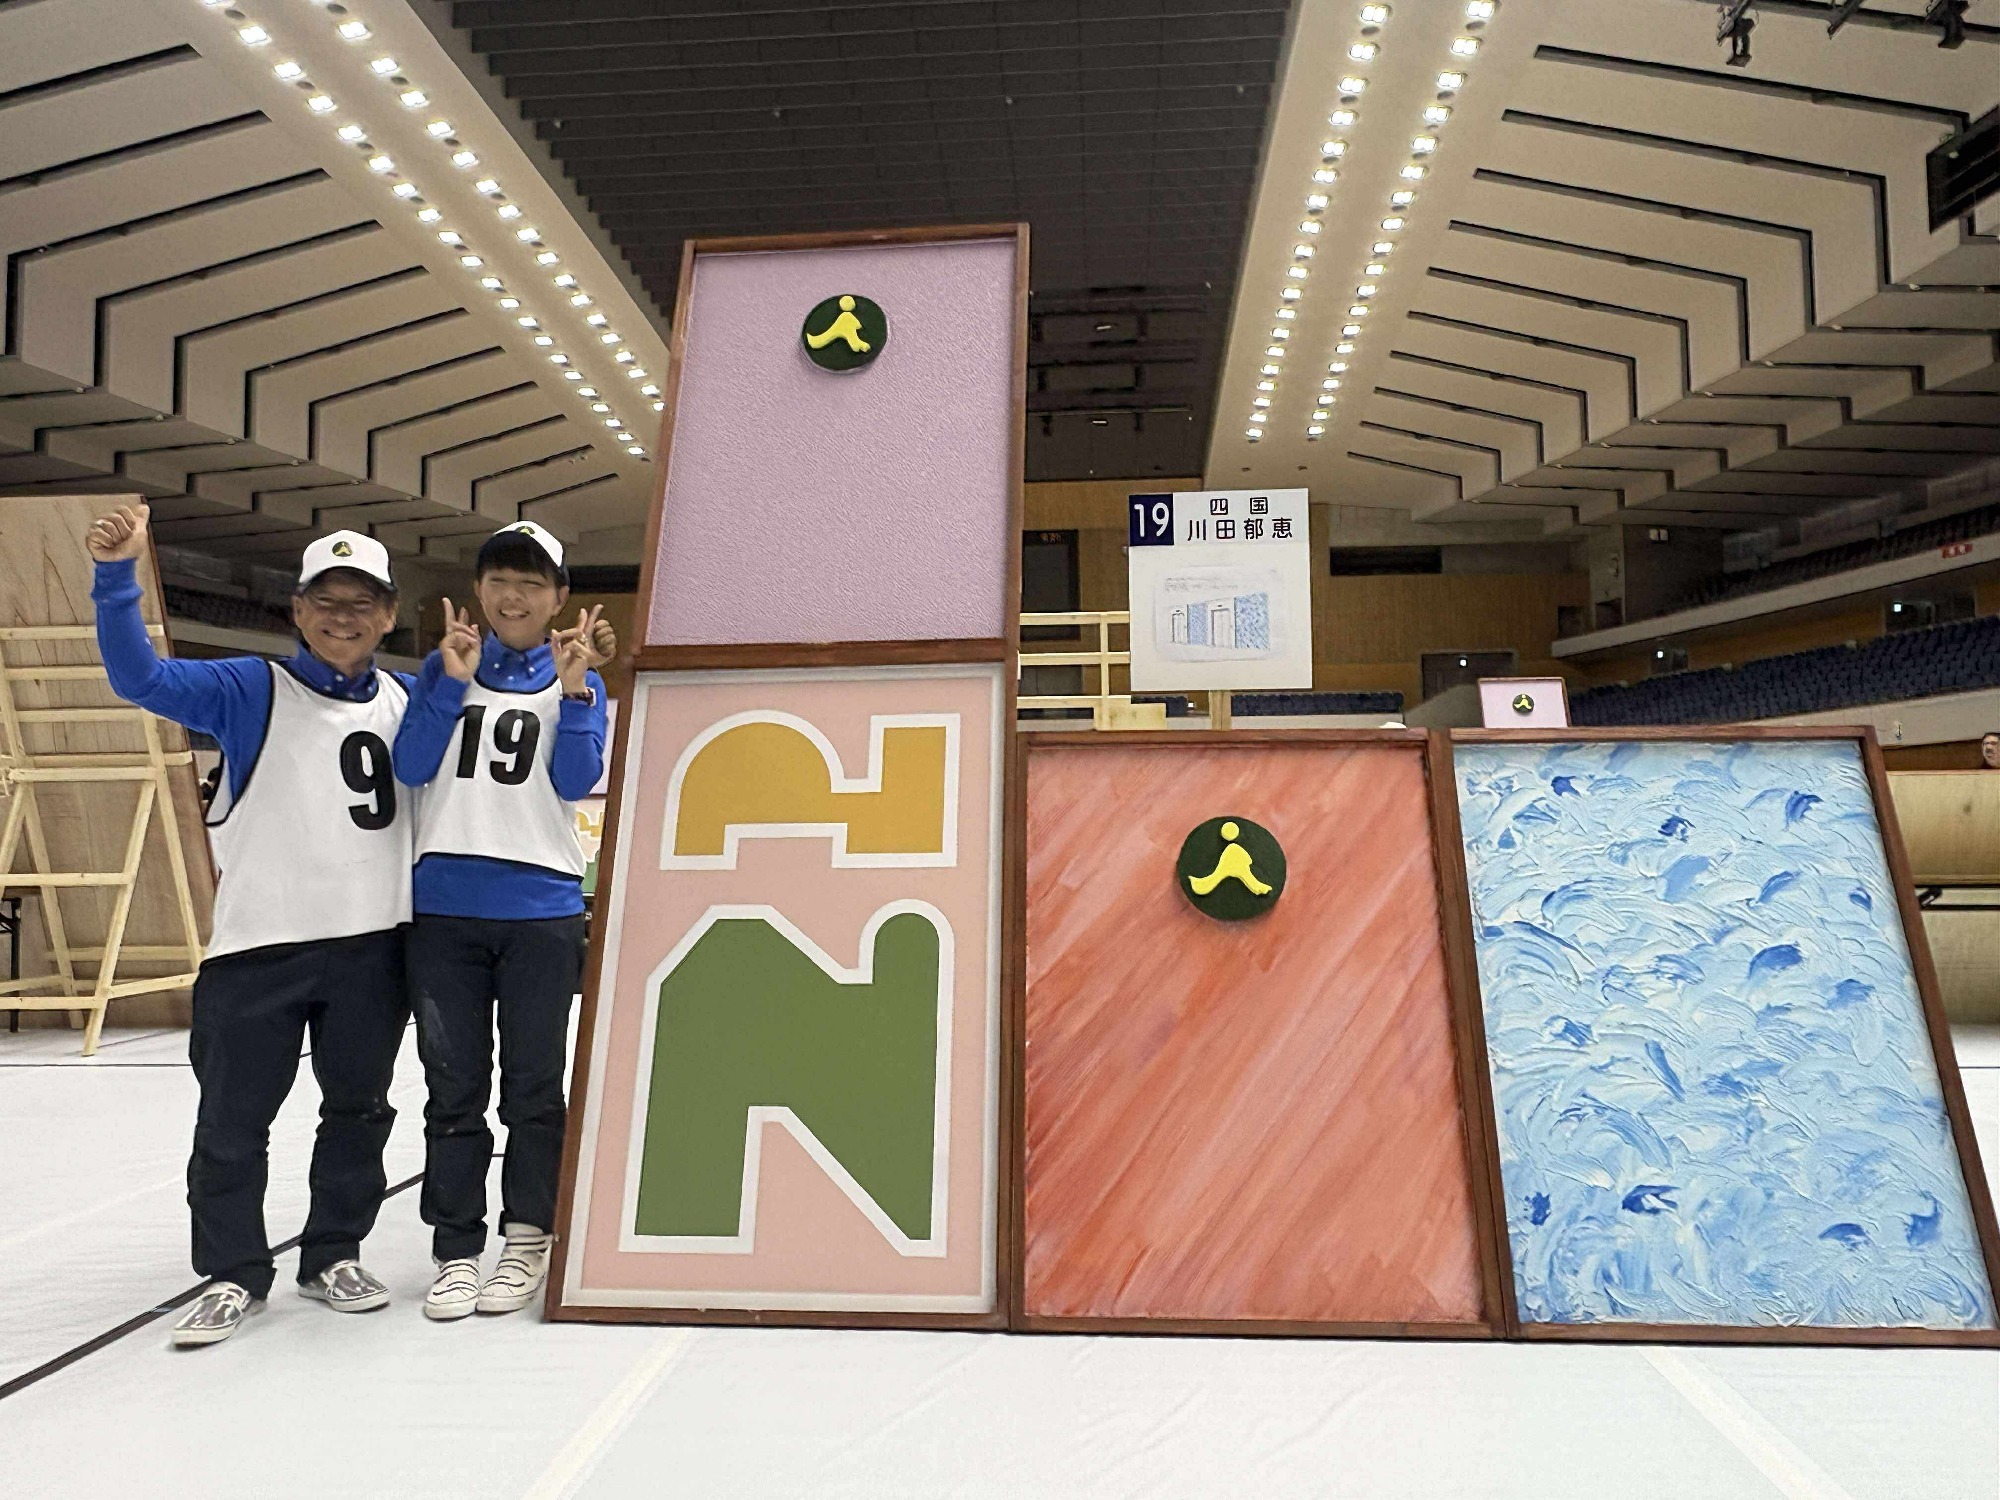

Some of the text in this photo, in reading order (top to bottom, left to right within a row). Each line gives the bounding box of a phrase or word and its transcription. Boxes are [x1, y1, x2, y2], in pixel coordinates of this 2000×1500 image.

[1134, 502, 1170, 538] 19
[1210, 497, 1268, 515] 四国
[1187, 517, 1293, 541] 川田郁恵
[456, 704, 541, 785] 19
[340, 730, 397, 831] 9
